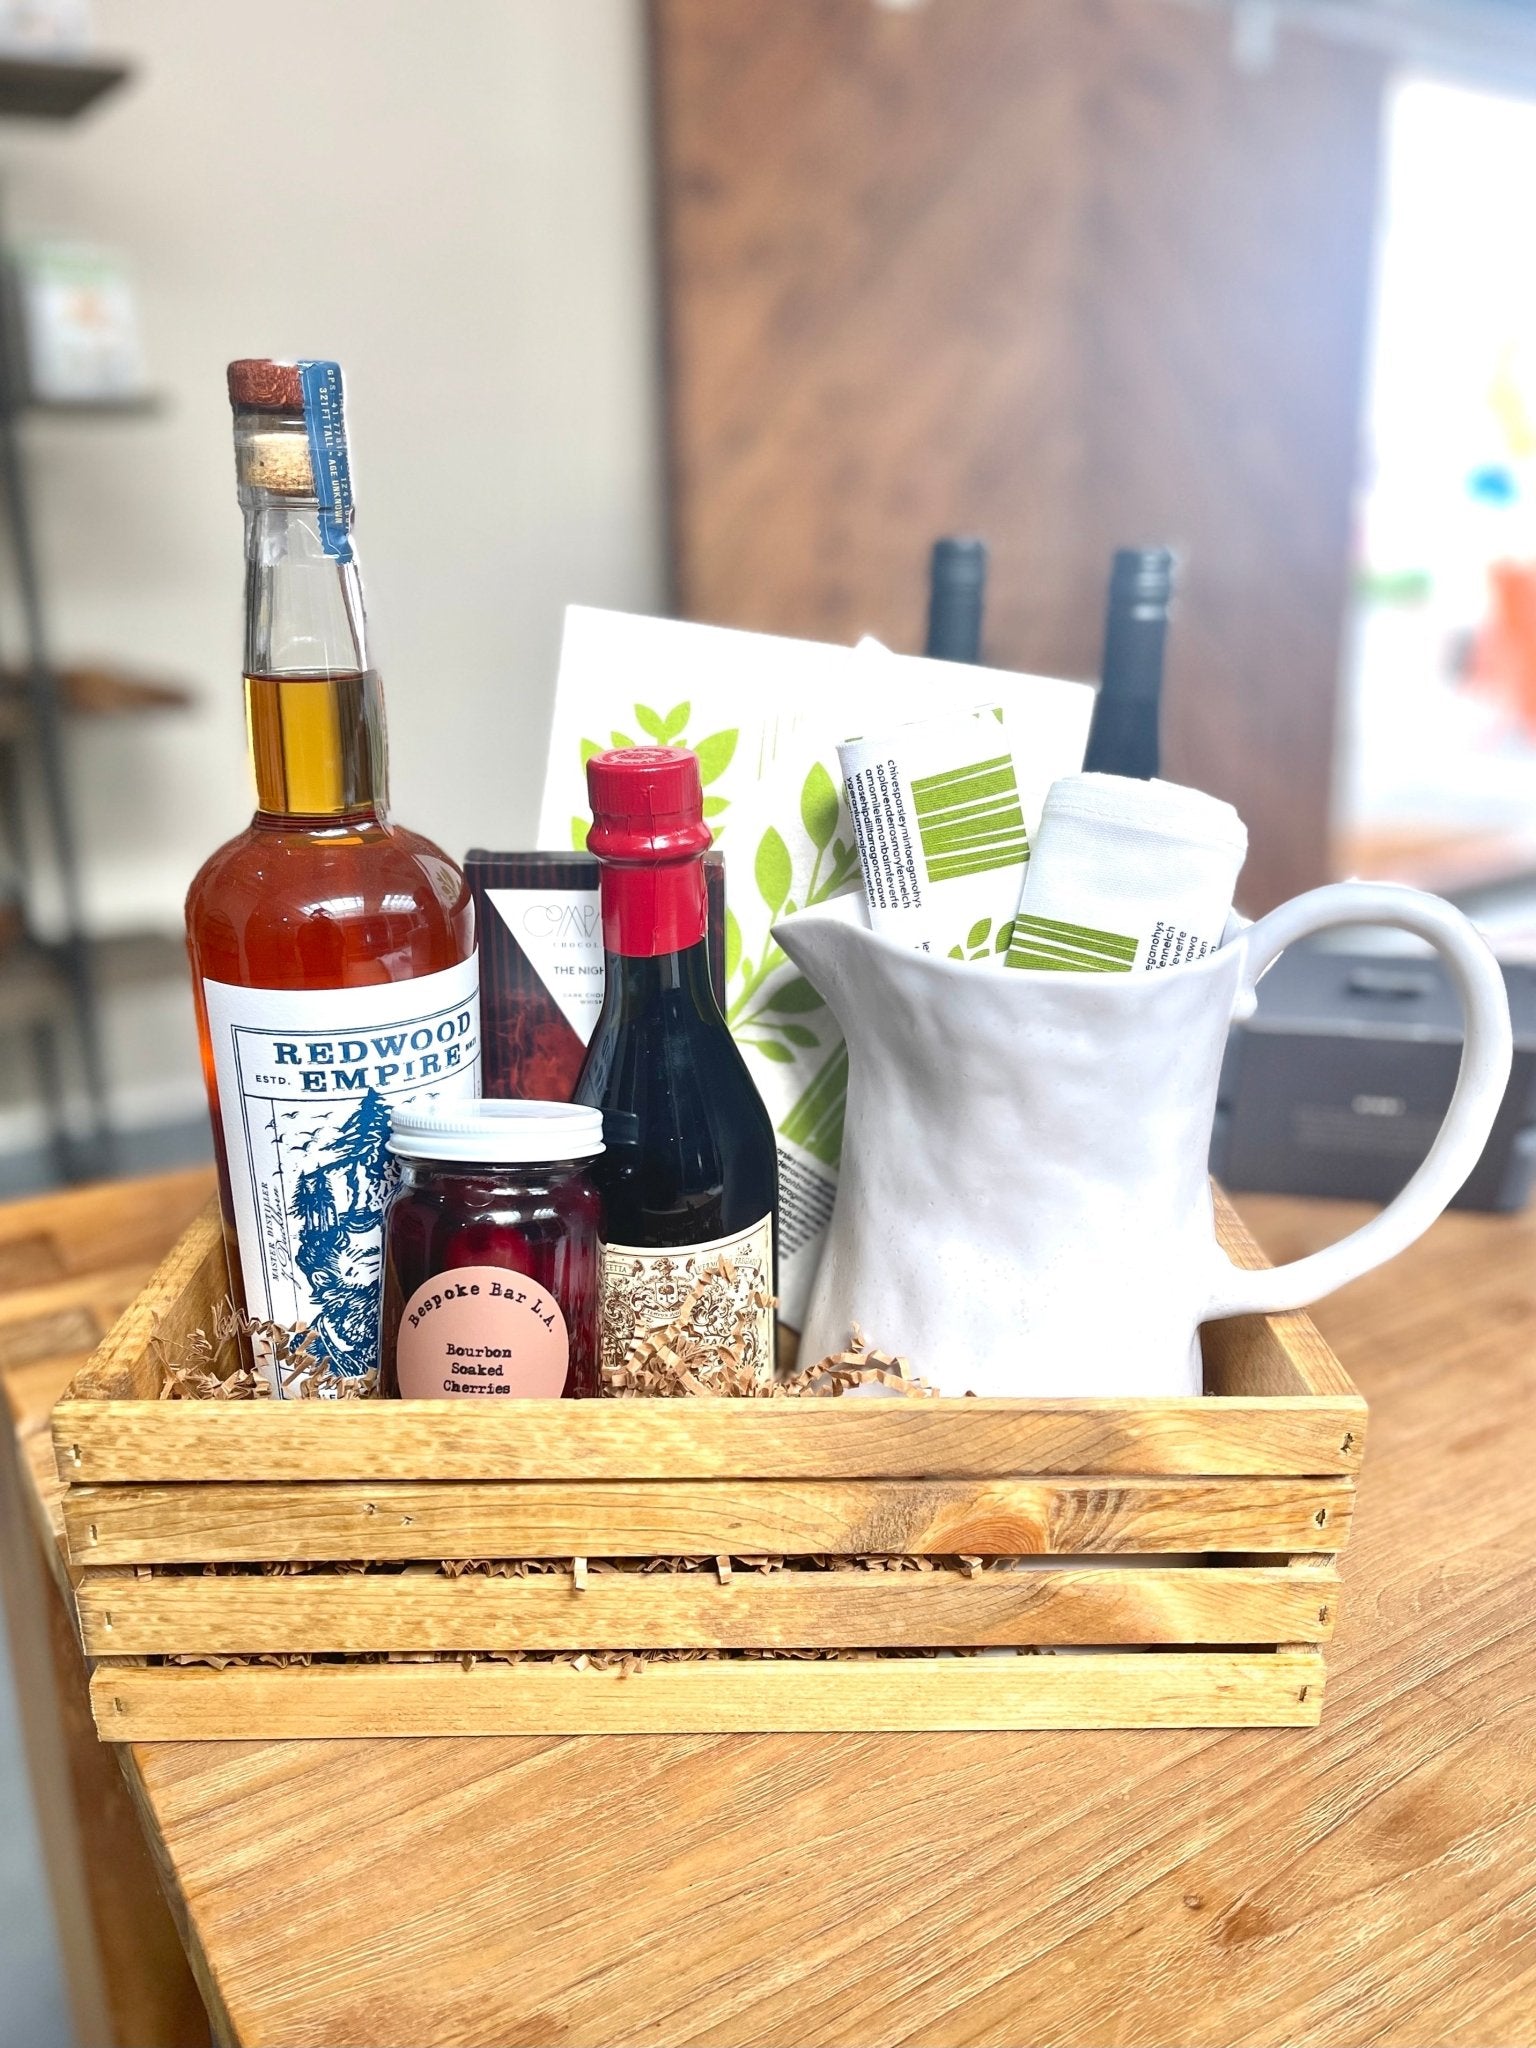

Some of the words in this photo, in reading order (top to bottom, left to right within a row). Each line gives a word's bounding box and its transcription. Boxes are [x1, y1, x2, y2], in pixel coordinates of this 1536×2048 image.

[323, 424, 334, 448] TALL
[328, 459, 338, 477] AGE
[331, 480, 343, 524] UNKNOWN
[554, 966, 575, 975] THE
[273, 1010, 471, 1066] REDWOOD
[255, 1074, 291, 1087] ESTD.
[299, 1043, 461, 1093] EMPIRE
[261, 1182, 275, 1238] DISTILLER
[268, 1242, 280, 1282] MASTER
[408, 1283, 480, 1329] Bespoke
[489, 1282, 527, 1304] Bar
[530, 1299, 557, 1333] L.A.
[445, 1343, 512, 1358] Bourbon
[451, 1362, 504, 1377] Soaked
[443, 1379, 511, 1395] Cherries
